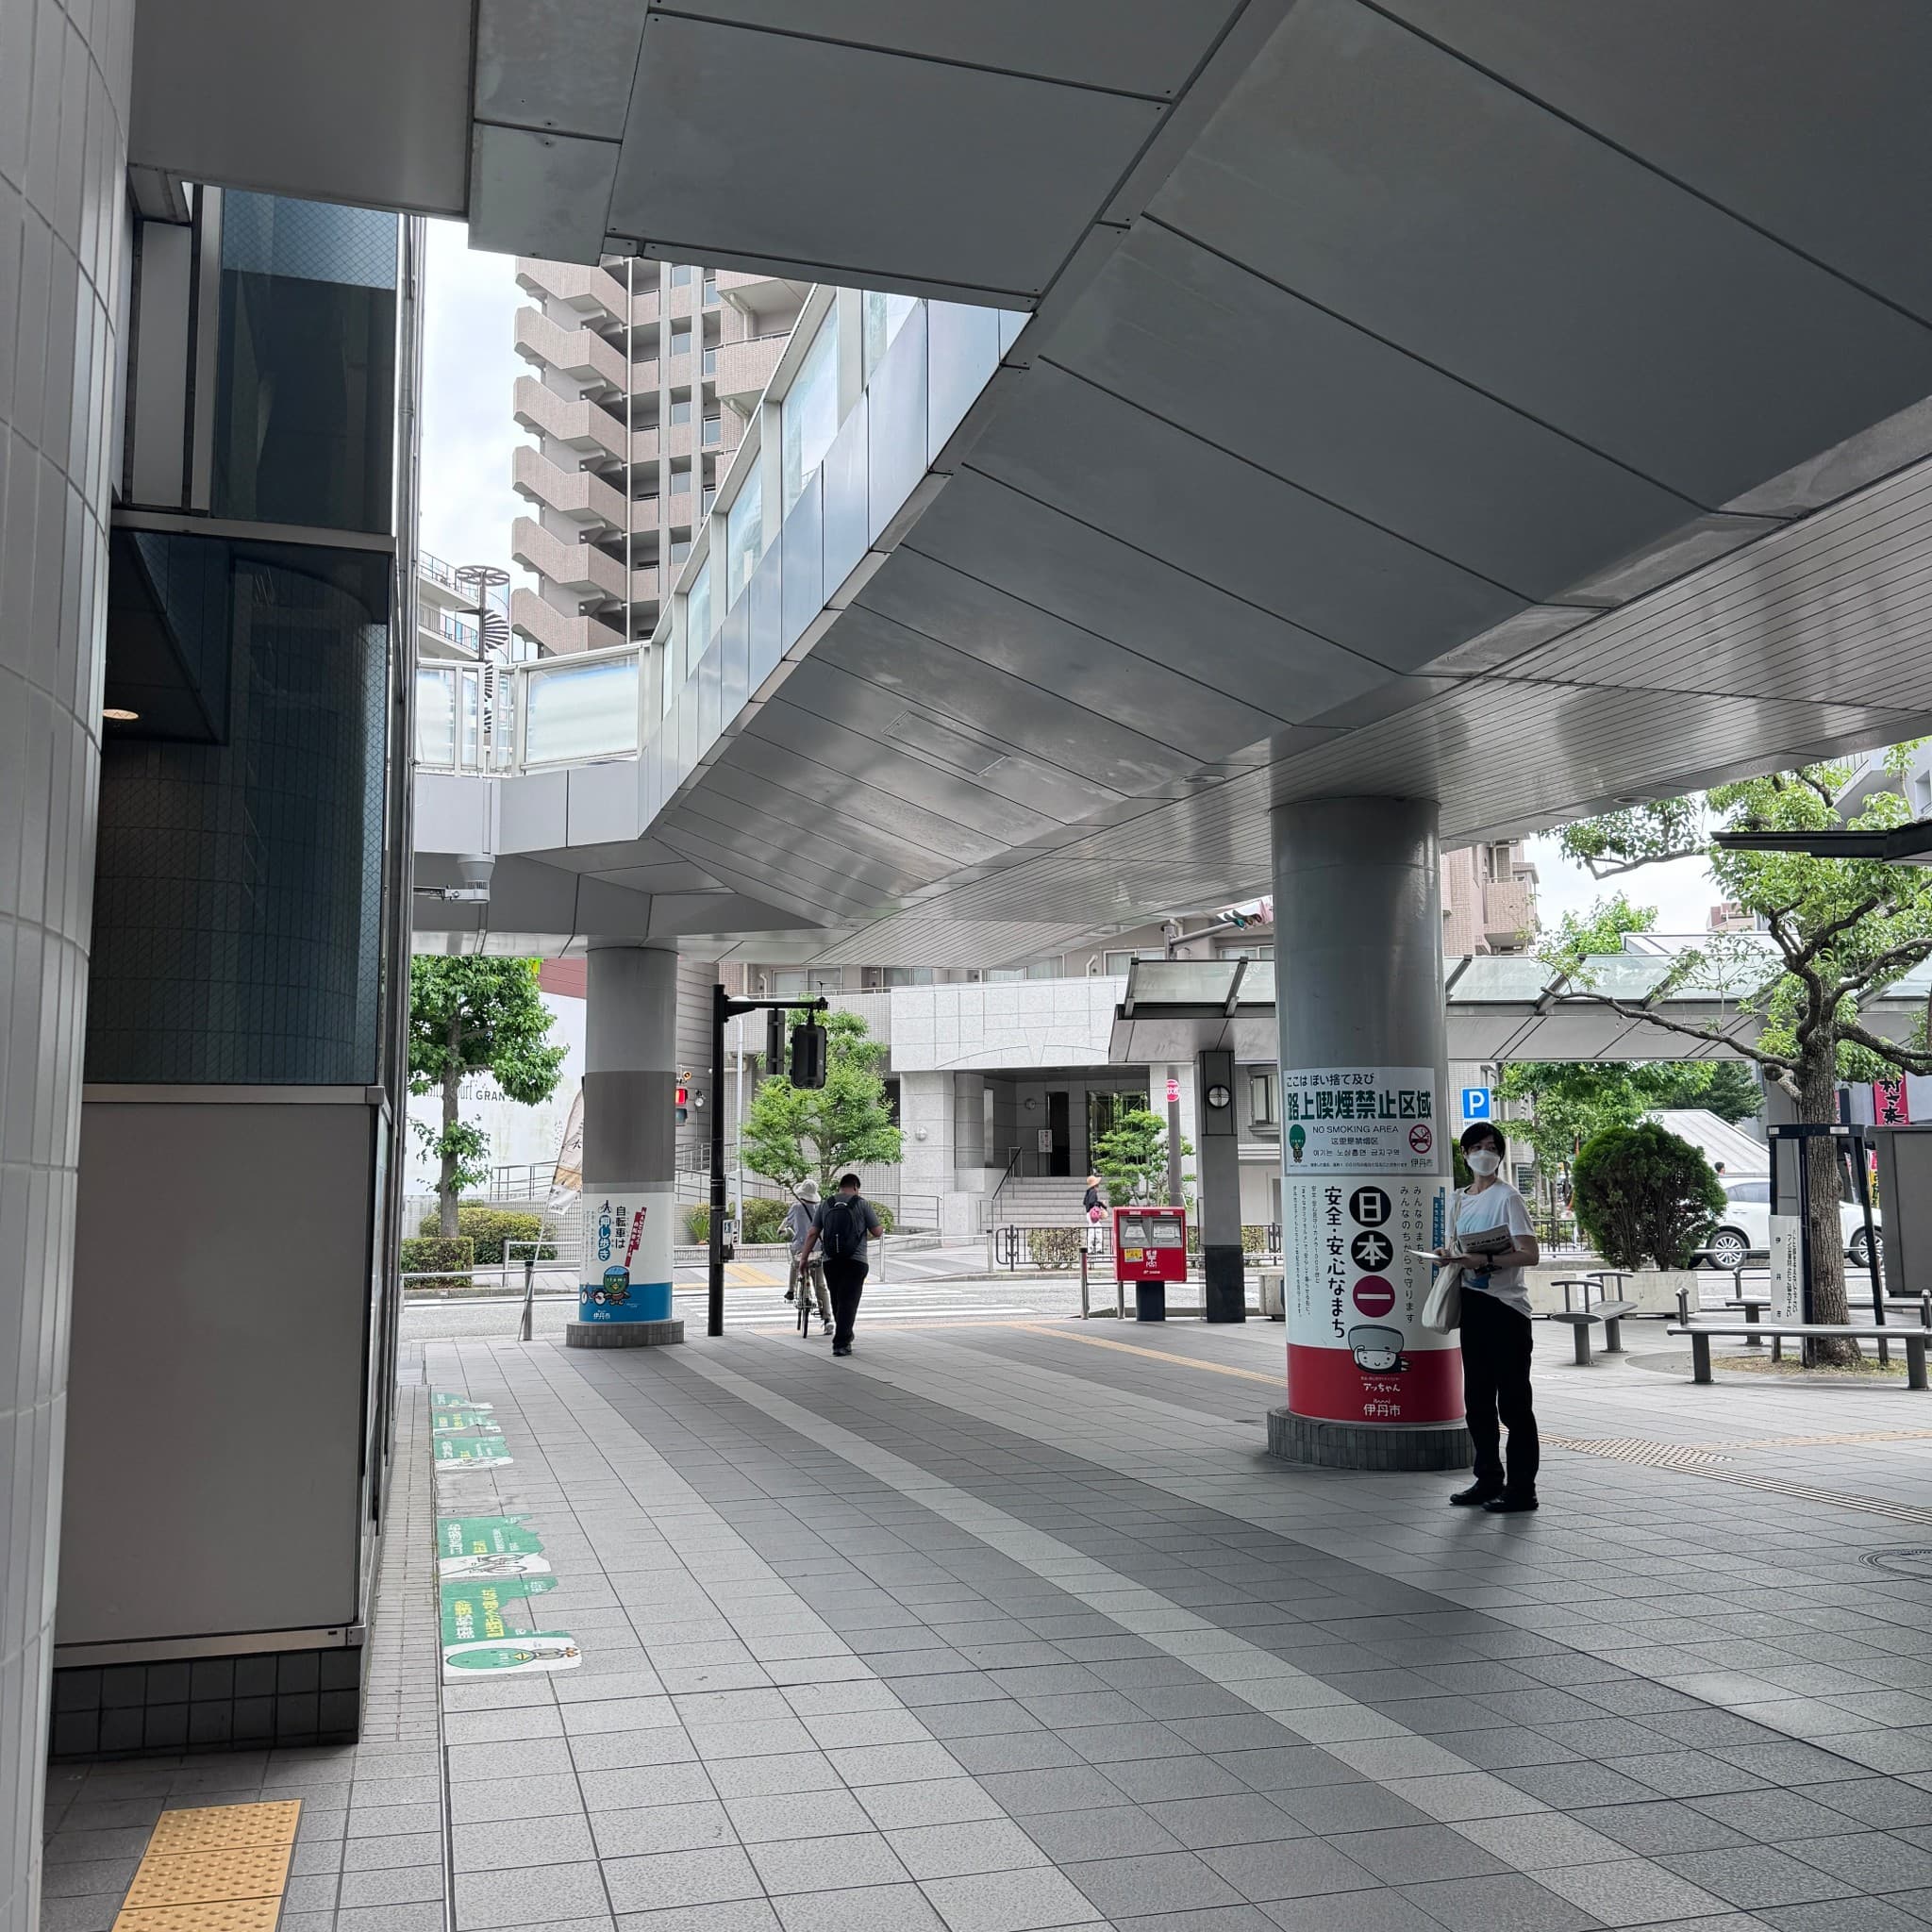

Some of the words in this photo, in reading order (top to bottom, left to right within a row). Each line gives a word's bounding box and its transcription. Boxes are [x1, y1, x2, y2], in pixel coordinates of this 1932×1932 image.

[1287, 1075, 1307, 1087] ここは
[475, 1090, 506, 1101] GRAN
[1288, 1090, 1433, 1121] 路上喫煙禁止区域
[1469, 1091, 1486, 1116] P
[1878, 1076, 1906, 1124] 村さ来
[1312, 1125, 1325, 1134] NO
[1326, 1124, 1371, 1134] SMOKING
[1373, 1124, 1399, 1133] AREA
[599, 1216, 611, 1261] 押し歩き
[615, 1206, 626, 1250] 自転車は
[1324, 1185, 1346, 1339] 安全・安心なまち
[1363, 1403, 1402, 1417] 伊丹市
